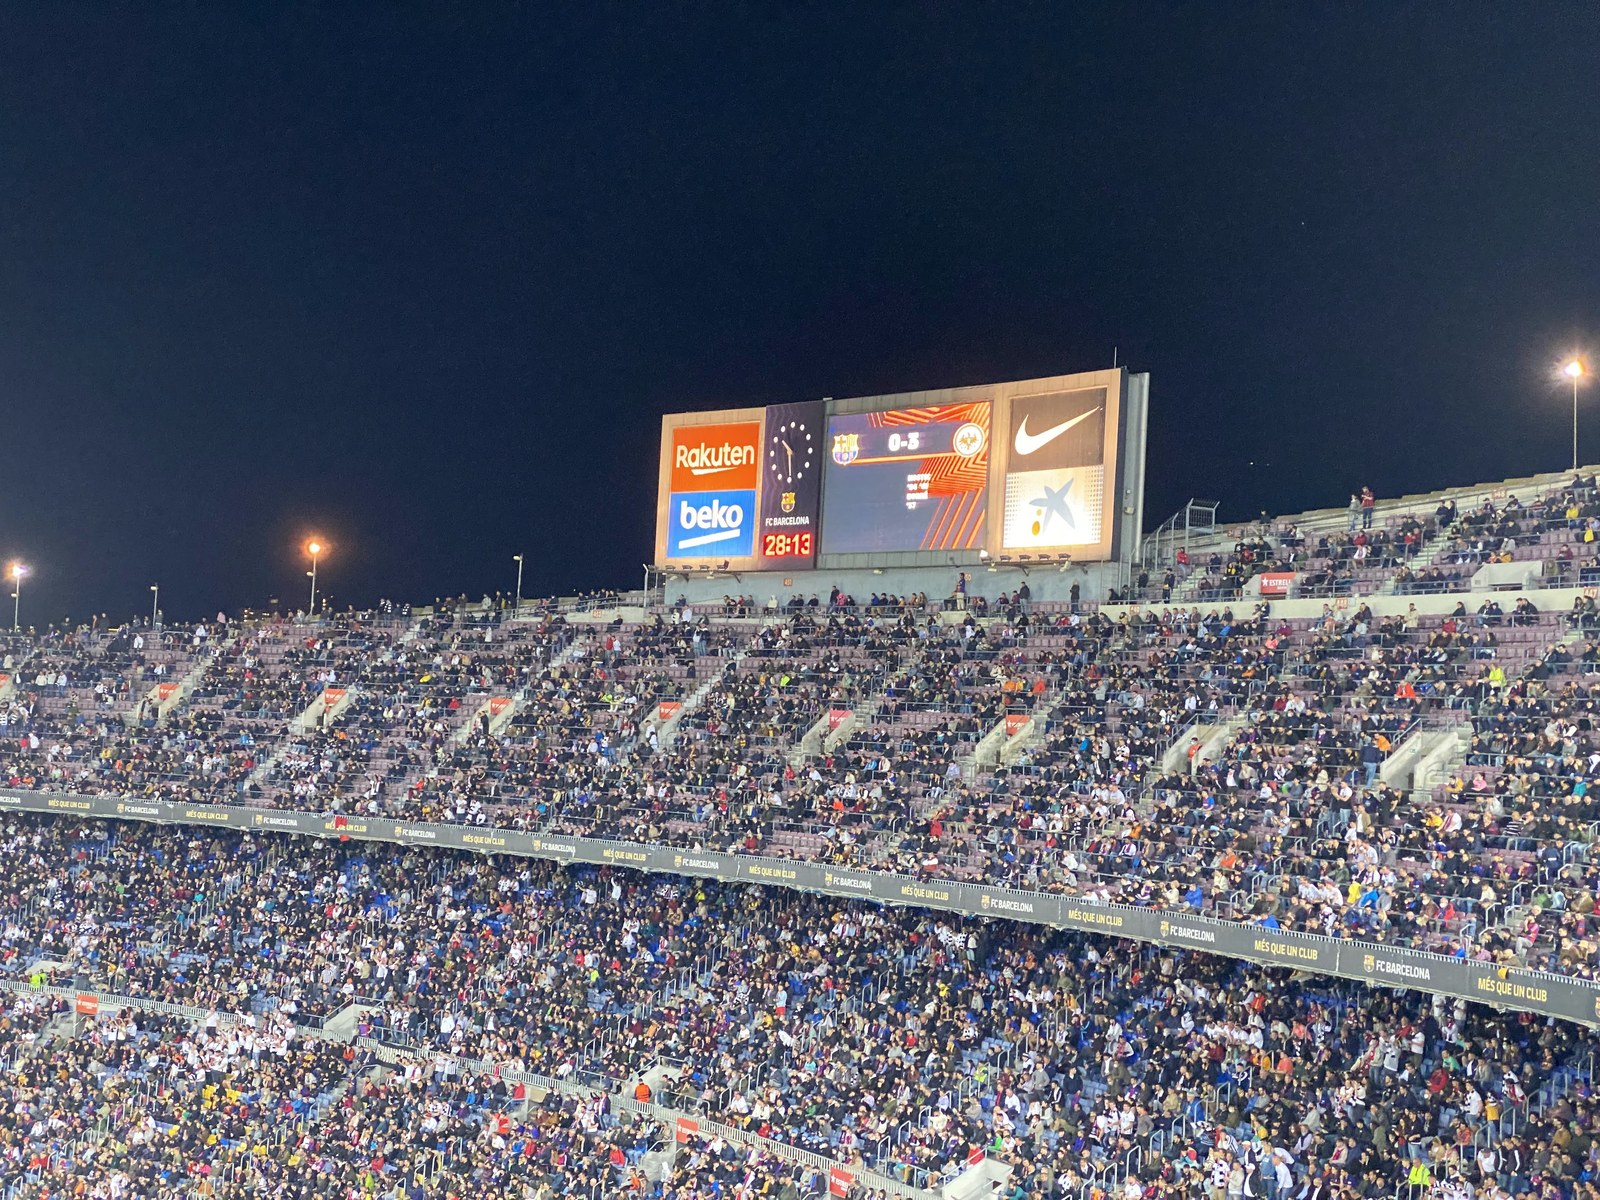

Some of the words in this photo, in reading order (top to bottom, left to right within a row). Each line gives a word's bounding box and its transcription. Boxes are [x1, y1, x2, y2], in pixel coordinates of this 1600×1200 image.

[888, 432, 920, 451] 0-3
[676, 441, 754, 469] Rakuten
[680, 499, 744, 529] beko
[765, 518, 773, 526] FC
[774, 516, 810, 526] BARCELONA
[765, 533, 811, 556] 28:13
[131, 806, 158, 814] BARCELONA
[270, 817, 297, 826] BARCELONA
[409, 830, 435, 839] BARCELONA
[548, 844, 576, 853] BARCELONA
[690, 860, 719, 870] BARCELONA
[749, 865, 760, 874] MÉS
[761, 867, 772, 876] QUE
[773, 869, 780, 877] UN
[782, 870, 796, 879] CLUB
[833, 877, 839, 885] FC
[840, 878, 872, 890] BARCELONA
[902, 885, 913, 894] MÉS
[914, 889, 924, 898] QUE
[926, 890, 933, 898] UN
[934, 891, 948, 900] CLUB
[991, 899, 998, 908] FC
[999, 900, 1033, 912] BARCELONA
[1068, 908, 1082, 920] MÉS
[1082, 912, 1095, 923] QUE
[1096, 913, 1105, 924] UN
[1106, 915, 1122, 926] CLUB
[1170, 925, 1178, 936] FC
[1178, 927, 1215, 942] BARCELONA
[1254, 939, 1269, 952] MÉS
[1270, 944, 1285, 956] QUE
[1286, 945, 1298, 957] UN
[1299, 947, 1318, 960] CLUB
[1376, 960, 1385, 971] FC
[1386, 961, 1430, 980] BARCELONA
[1478, 977, 1495, 992] MÉS
[1496, 982, 1512, 997] QUE
[1513, 985, 1526, 998] UN
[1526, 986, 1547, 1002] CLUB
